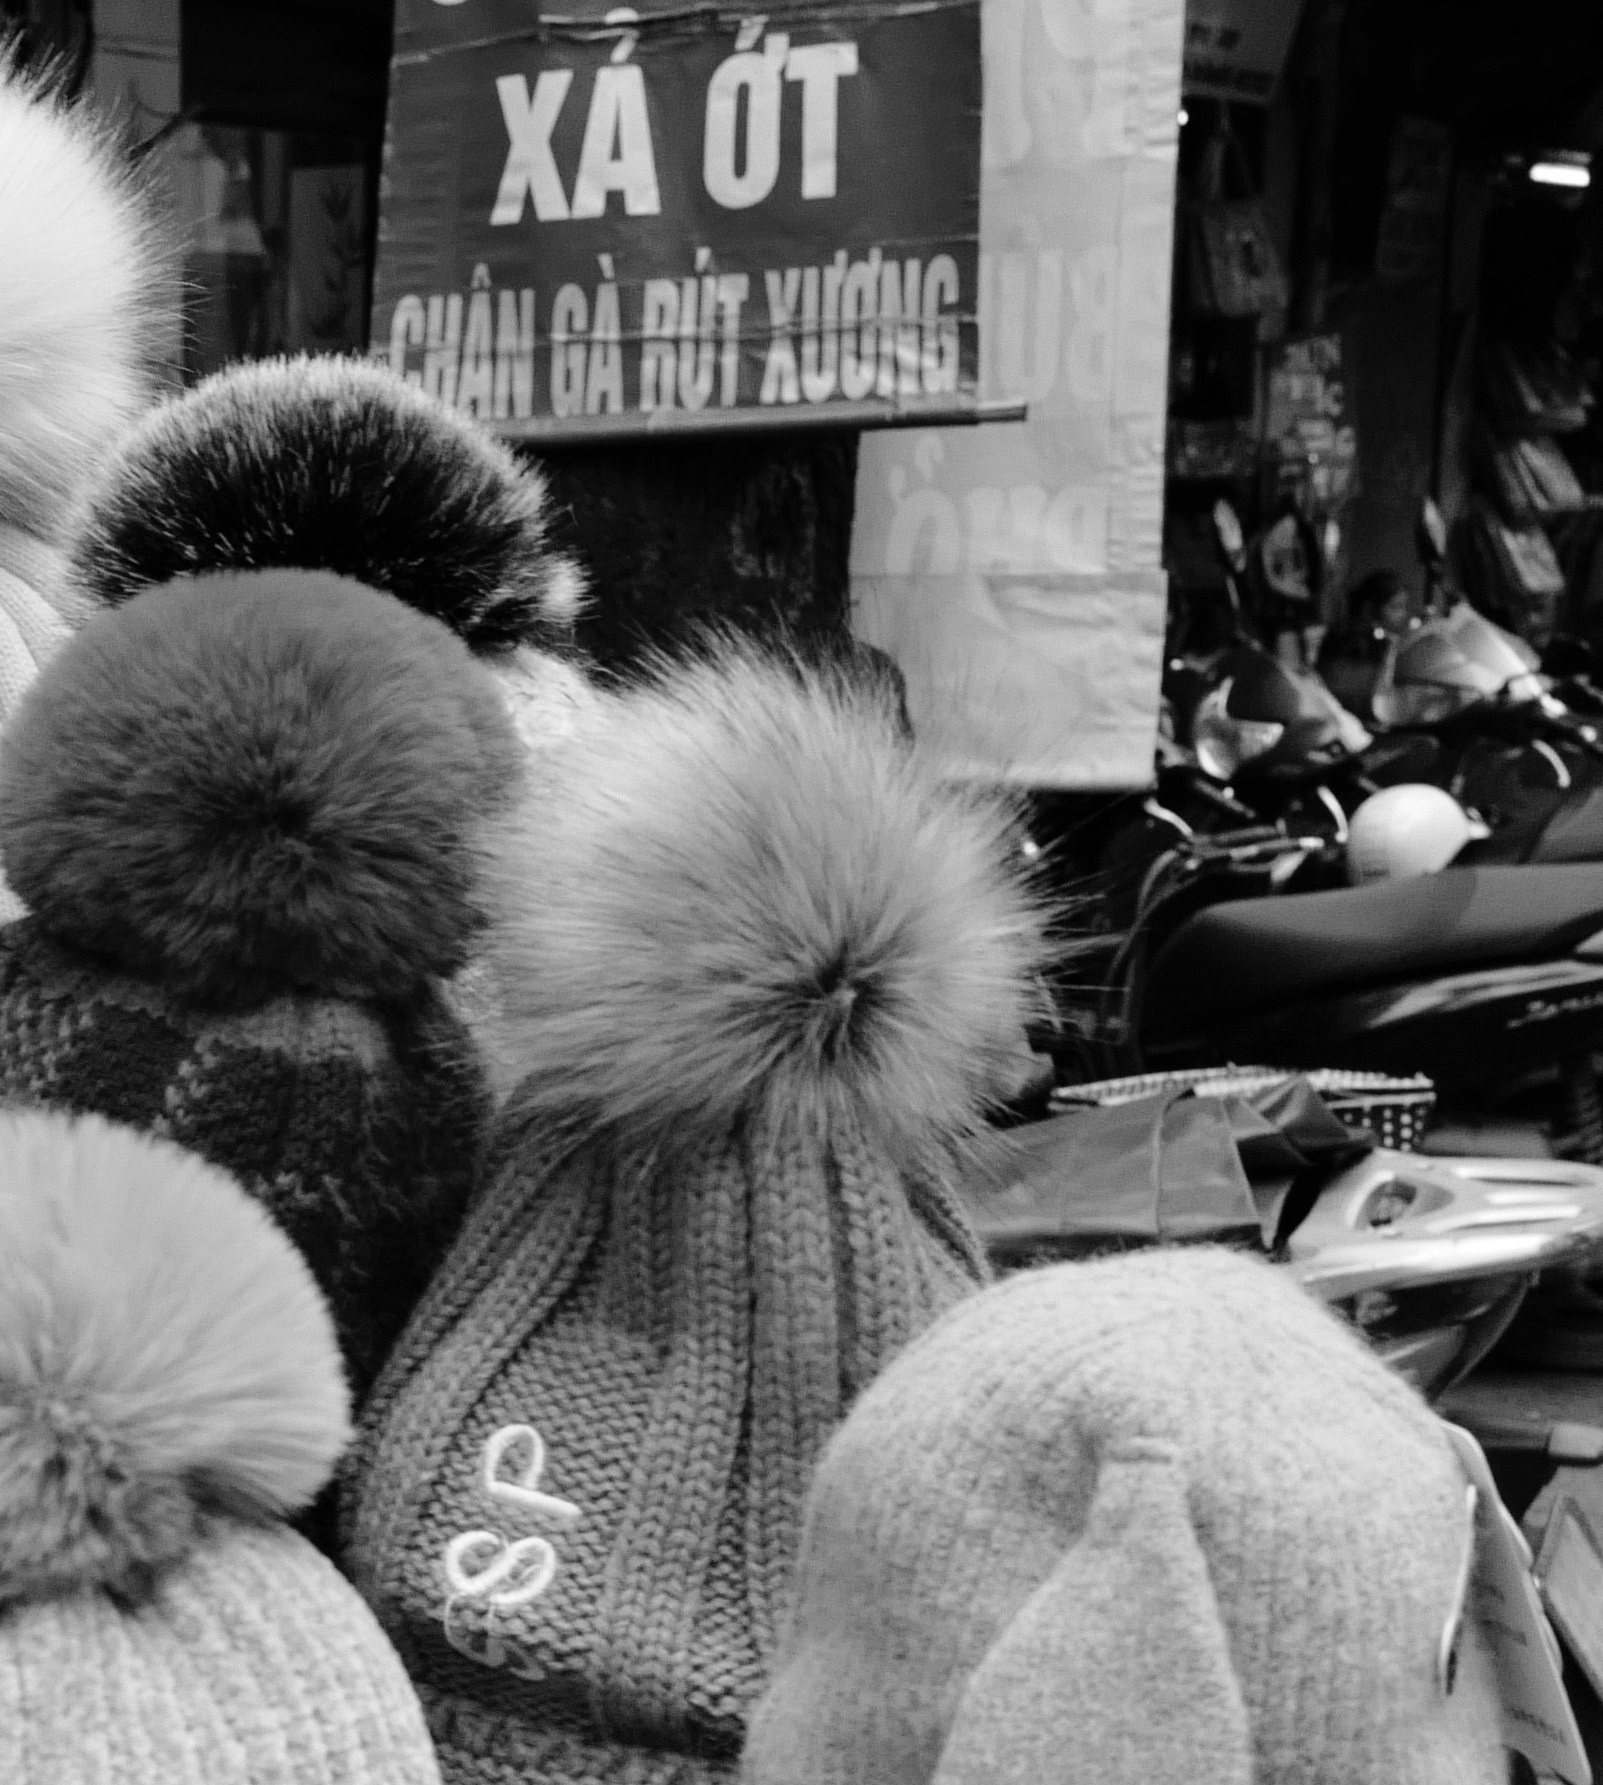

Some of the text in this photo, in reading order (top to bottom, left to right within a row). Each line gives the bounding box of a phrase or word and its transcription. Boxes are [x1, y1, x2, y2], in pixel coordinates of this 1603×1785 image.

[702, 14, 859, 210] ỚT
[390, 246, 960, 420] CHÂN GÀ RÚT XƯƠNG
